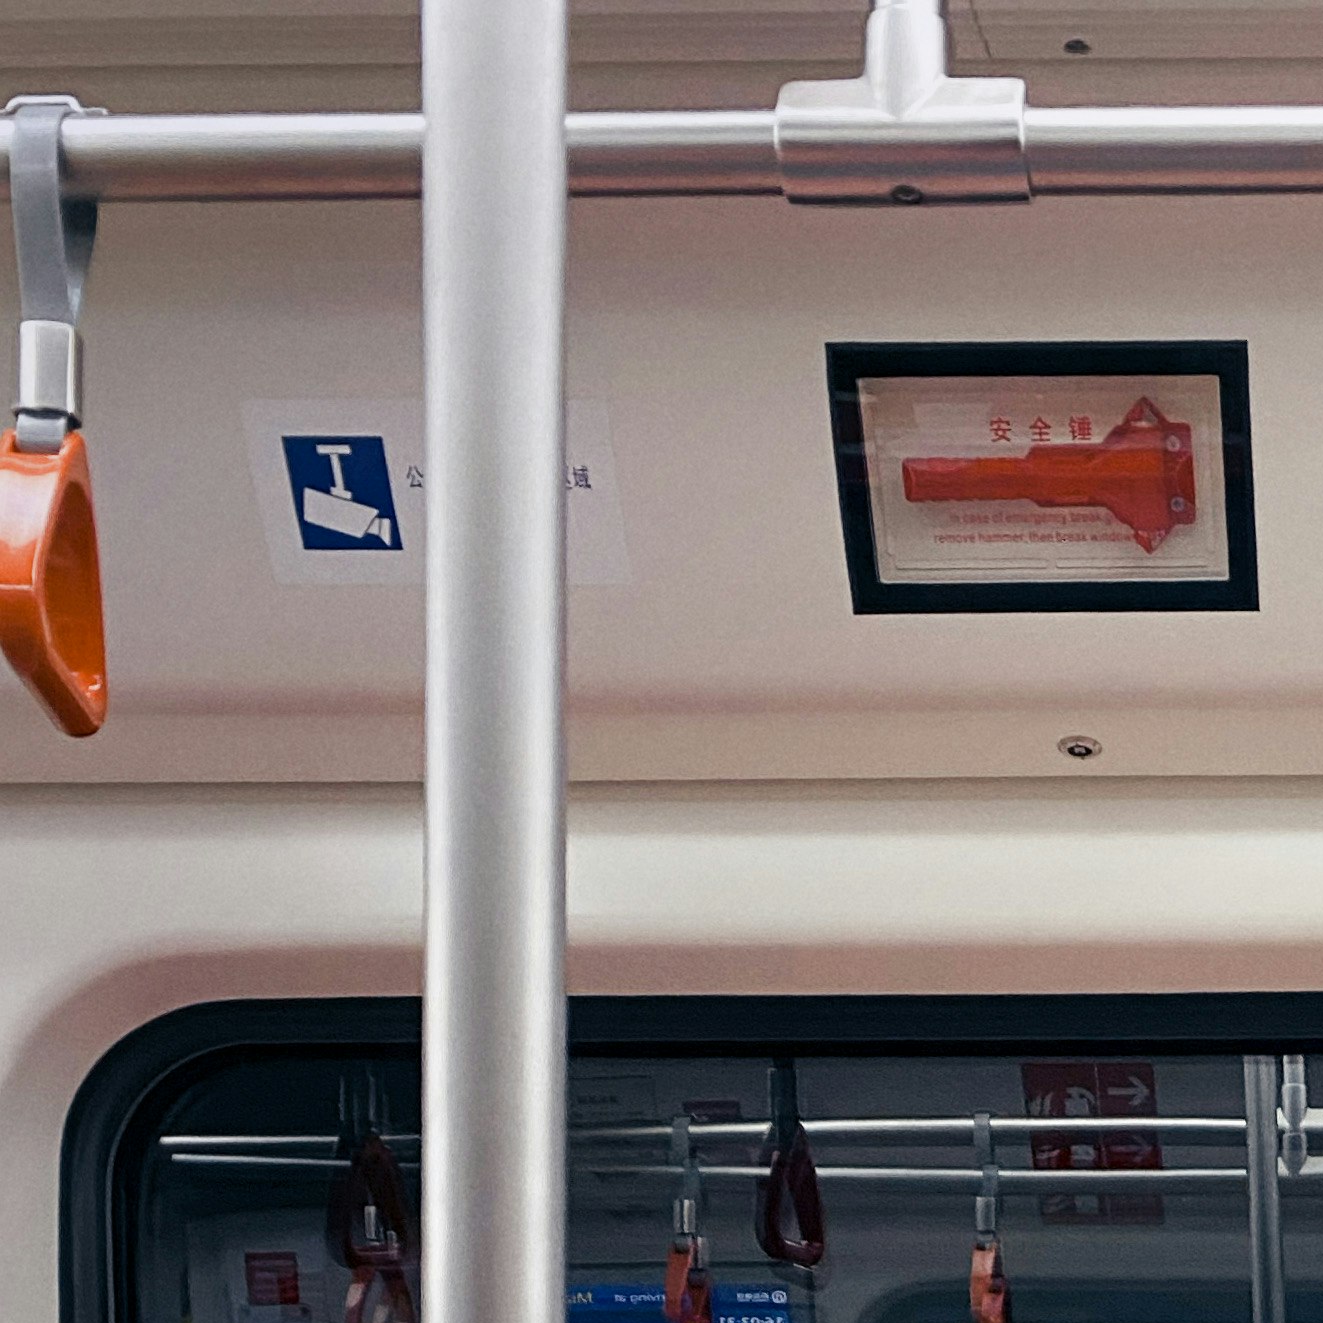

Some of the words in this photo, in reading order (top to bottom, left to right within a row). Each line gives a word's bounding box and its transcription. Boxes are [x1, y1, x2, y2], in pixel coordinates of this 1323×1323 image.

[989, 415, 1093, 442] 安全锤
[565, 465, 592, 489] 域
